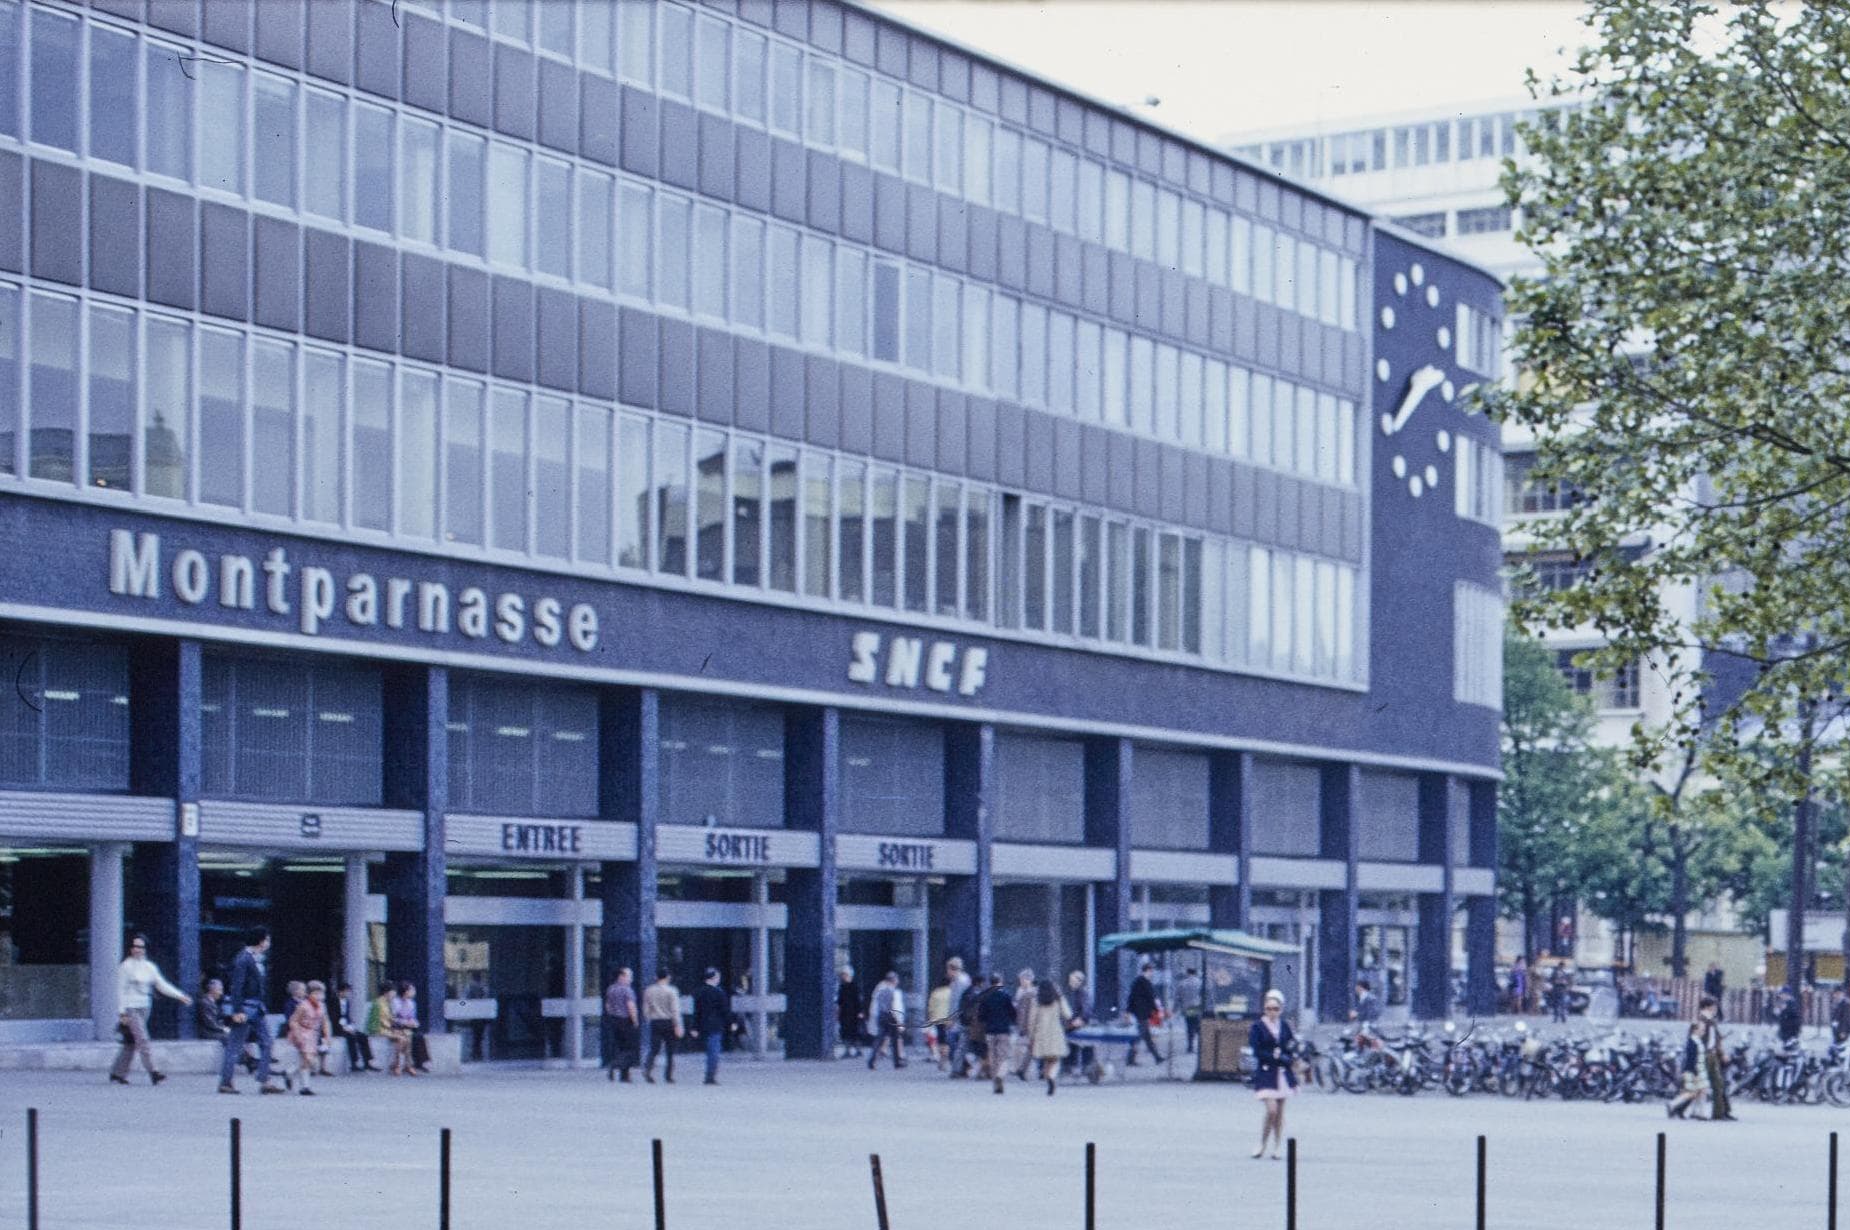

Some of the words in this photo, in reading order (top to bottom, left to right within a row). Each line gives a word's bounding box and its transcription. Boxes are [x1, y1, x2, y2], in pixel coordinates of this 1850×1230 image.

[109, 528, 600, 652] Montparnasse
[848, 630, 989, 696] SNCF
[502, 823, 581, 852] ENTREE
[705, 832, 770, 861] SORTIE
[878, 842, 934, 869] SORTIE
